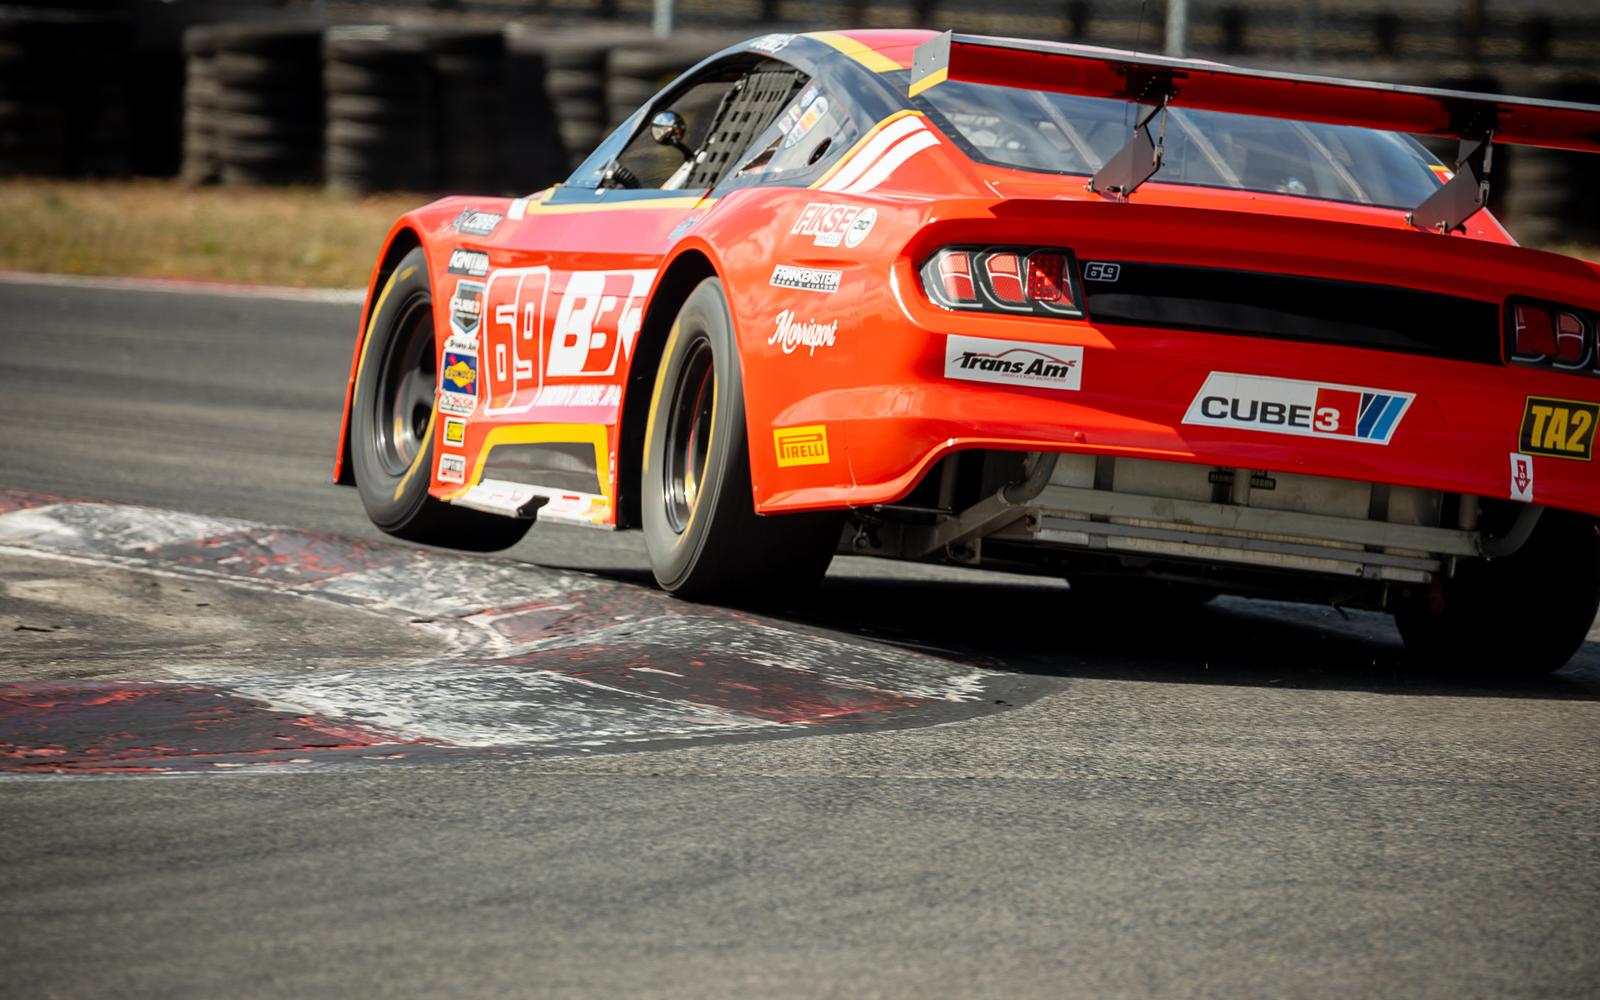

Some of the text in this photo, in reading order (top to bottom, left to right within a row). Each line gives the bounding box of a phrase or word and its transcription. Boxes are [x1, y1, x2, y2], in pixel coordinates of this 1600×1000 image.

[793, 204, 859, 234] FIKSE
[1084, 261, 1120, 282] 69
[484, 265, 550, 416] 69
[768, 309, 837, 357] Morrisport
[960, 352, 1069, 378] Trans Am
[1531, 405, 1592, 452] TA2
[779, 433, 825, 459] PIRELLI
[1518, 464, 1527, 487] TOW
